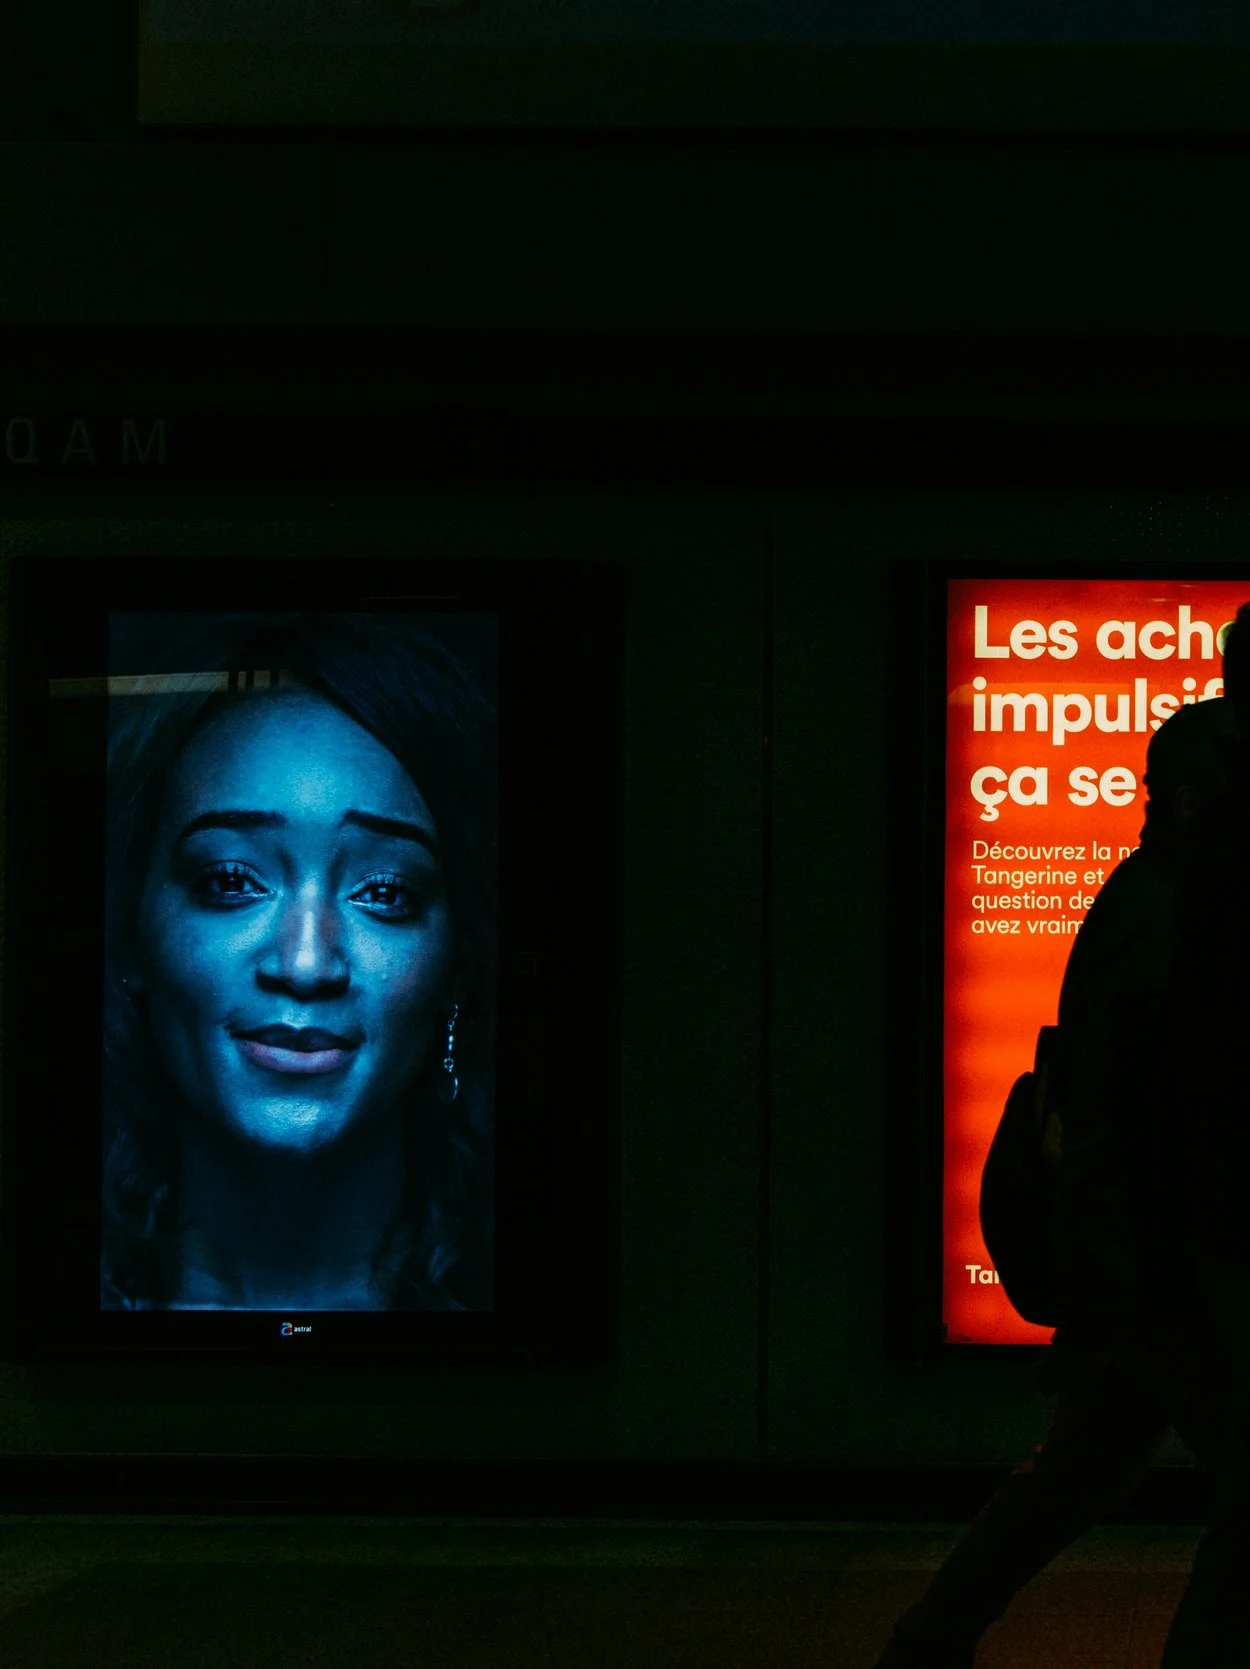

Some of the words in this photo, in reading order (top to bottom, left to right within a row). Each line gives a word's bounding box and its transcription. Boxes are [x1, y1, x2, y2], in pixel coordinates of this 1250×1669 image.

[975, 605, 1078, 660] Les
[1096, 605, 1236, 660] ach
[970, 766, 1049, 821] ça
[1067, 766, 1137, 806] se
[973, 840, 1086, 860] Découvrez
[1092, 840, 1111, 860] la
[972, 865, 1077, 889] Tangerine
[1083, 868, 1105, 885] et
[972, 890, 1062, 913] question
[1068, 890, 1095, 910] de
[972, 919, 1020, 934] avez
